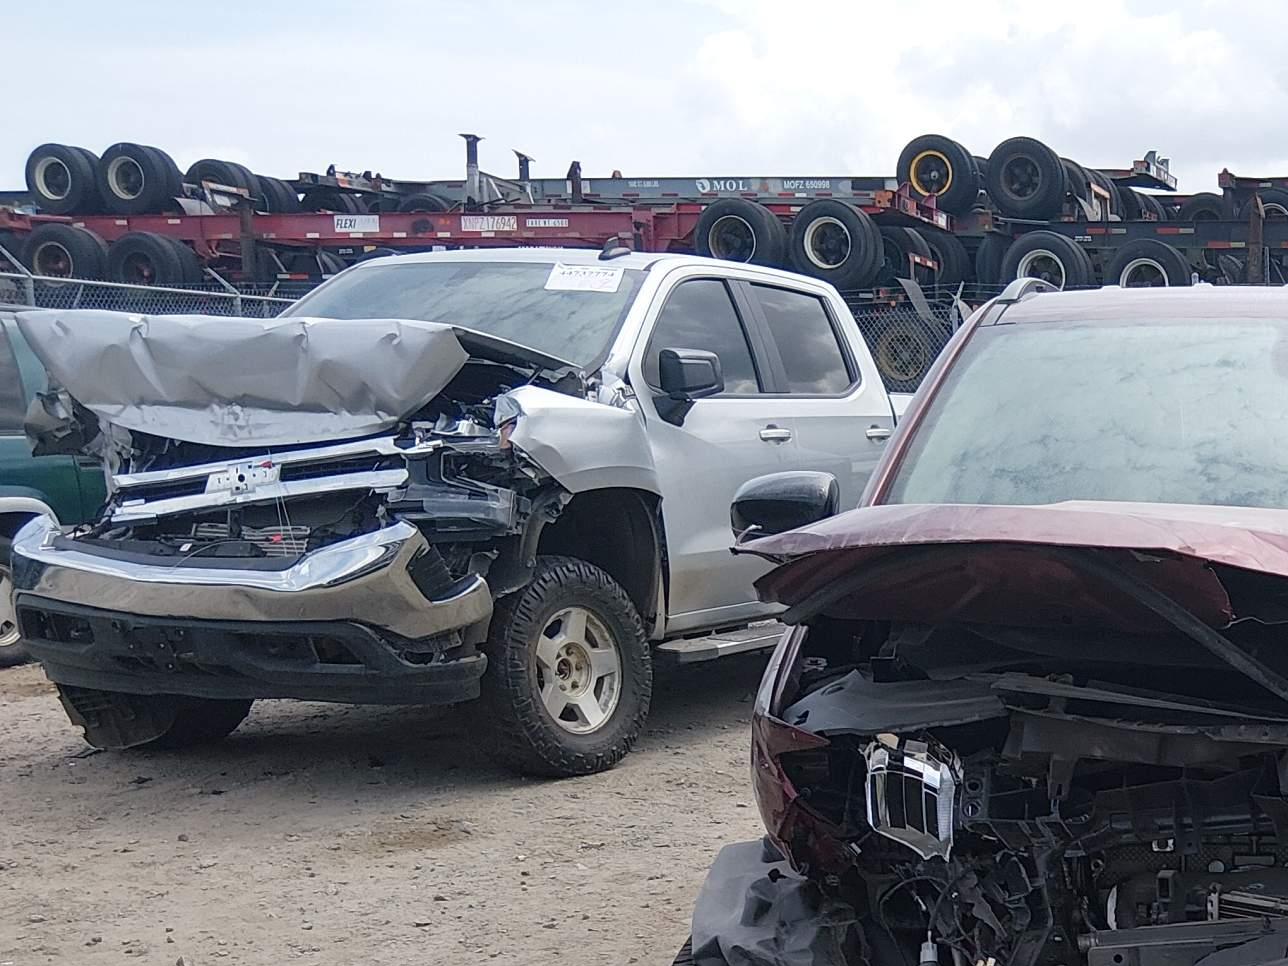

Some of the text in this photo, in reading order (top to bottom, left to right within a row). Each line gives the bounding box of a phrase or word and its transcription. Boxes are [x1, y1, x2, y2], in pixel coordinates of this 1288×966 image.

[713, 180, 748, 191] MOL
[784, 180, 804, 189] MOFZ
[335, 219, 357, 229] FLEXI
